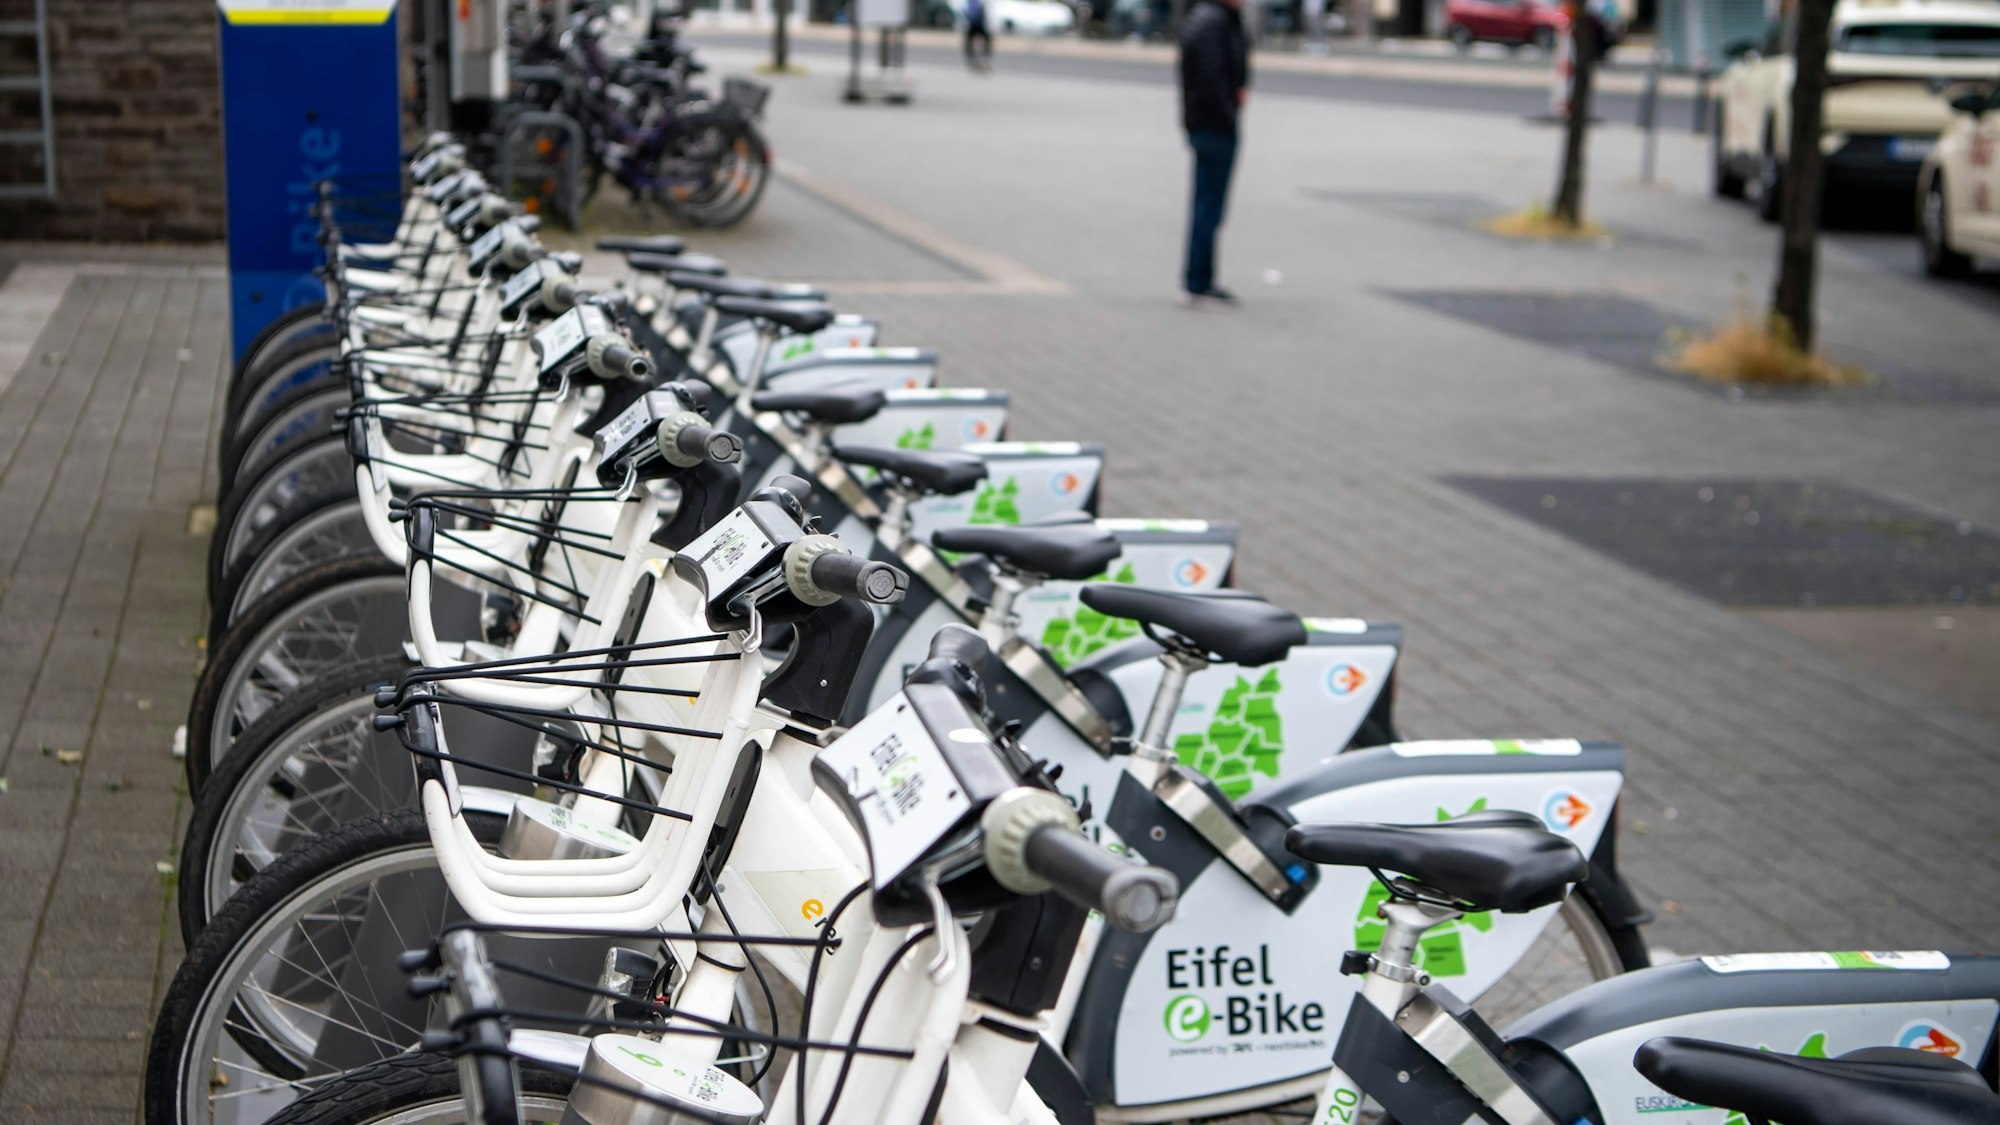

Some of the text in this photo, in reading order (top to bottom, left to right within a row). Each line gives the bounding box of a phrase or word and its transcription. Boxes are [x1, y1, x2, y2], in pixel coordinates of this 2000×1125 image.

[1166, 944, 1274, 990] Eifel
[1163, 993, 1325, 1044] e-Bike
[1322, 1088, 1358, 1125] 20
